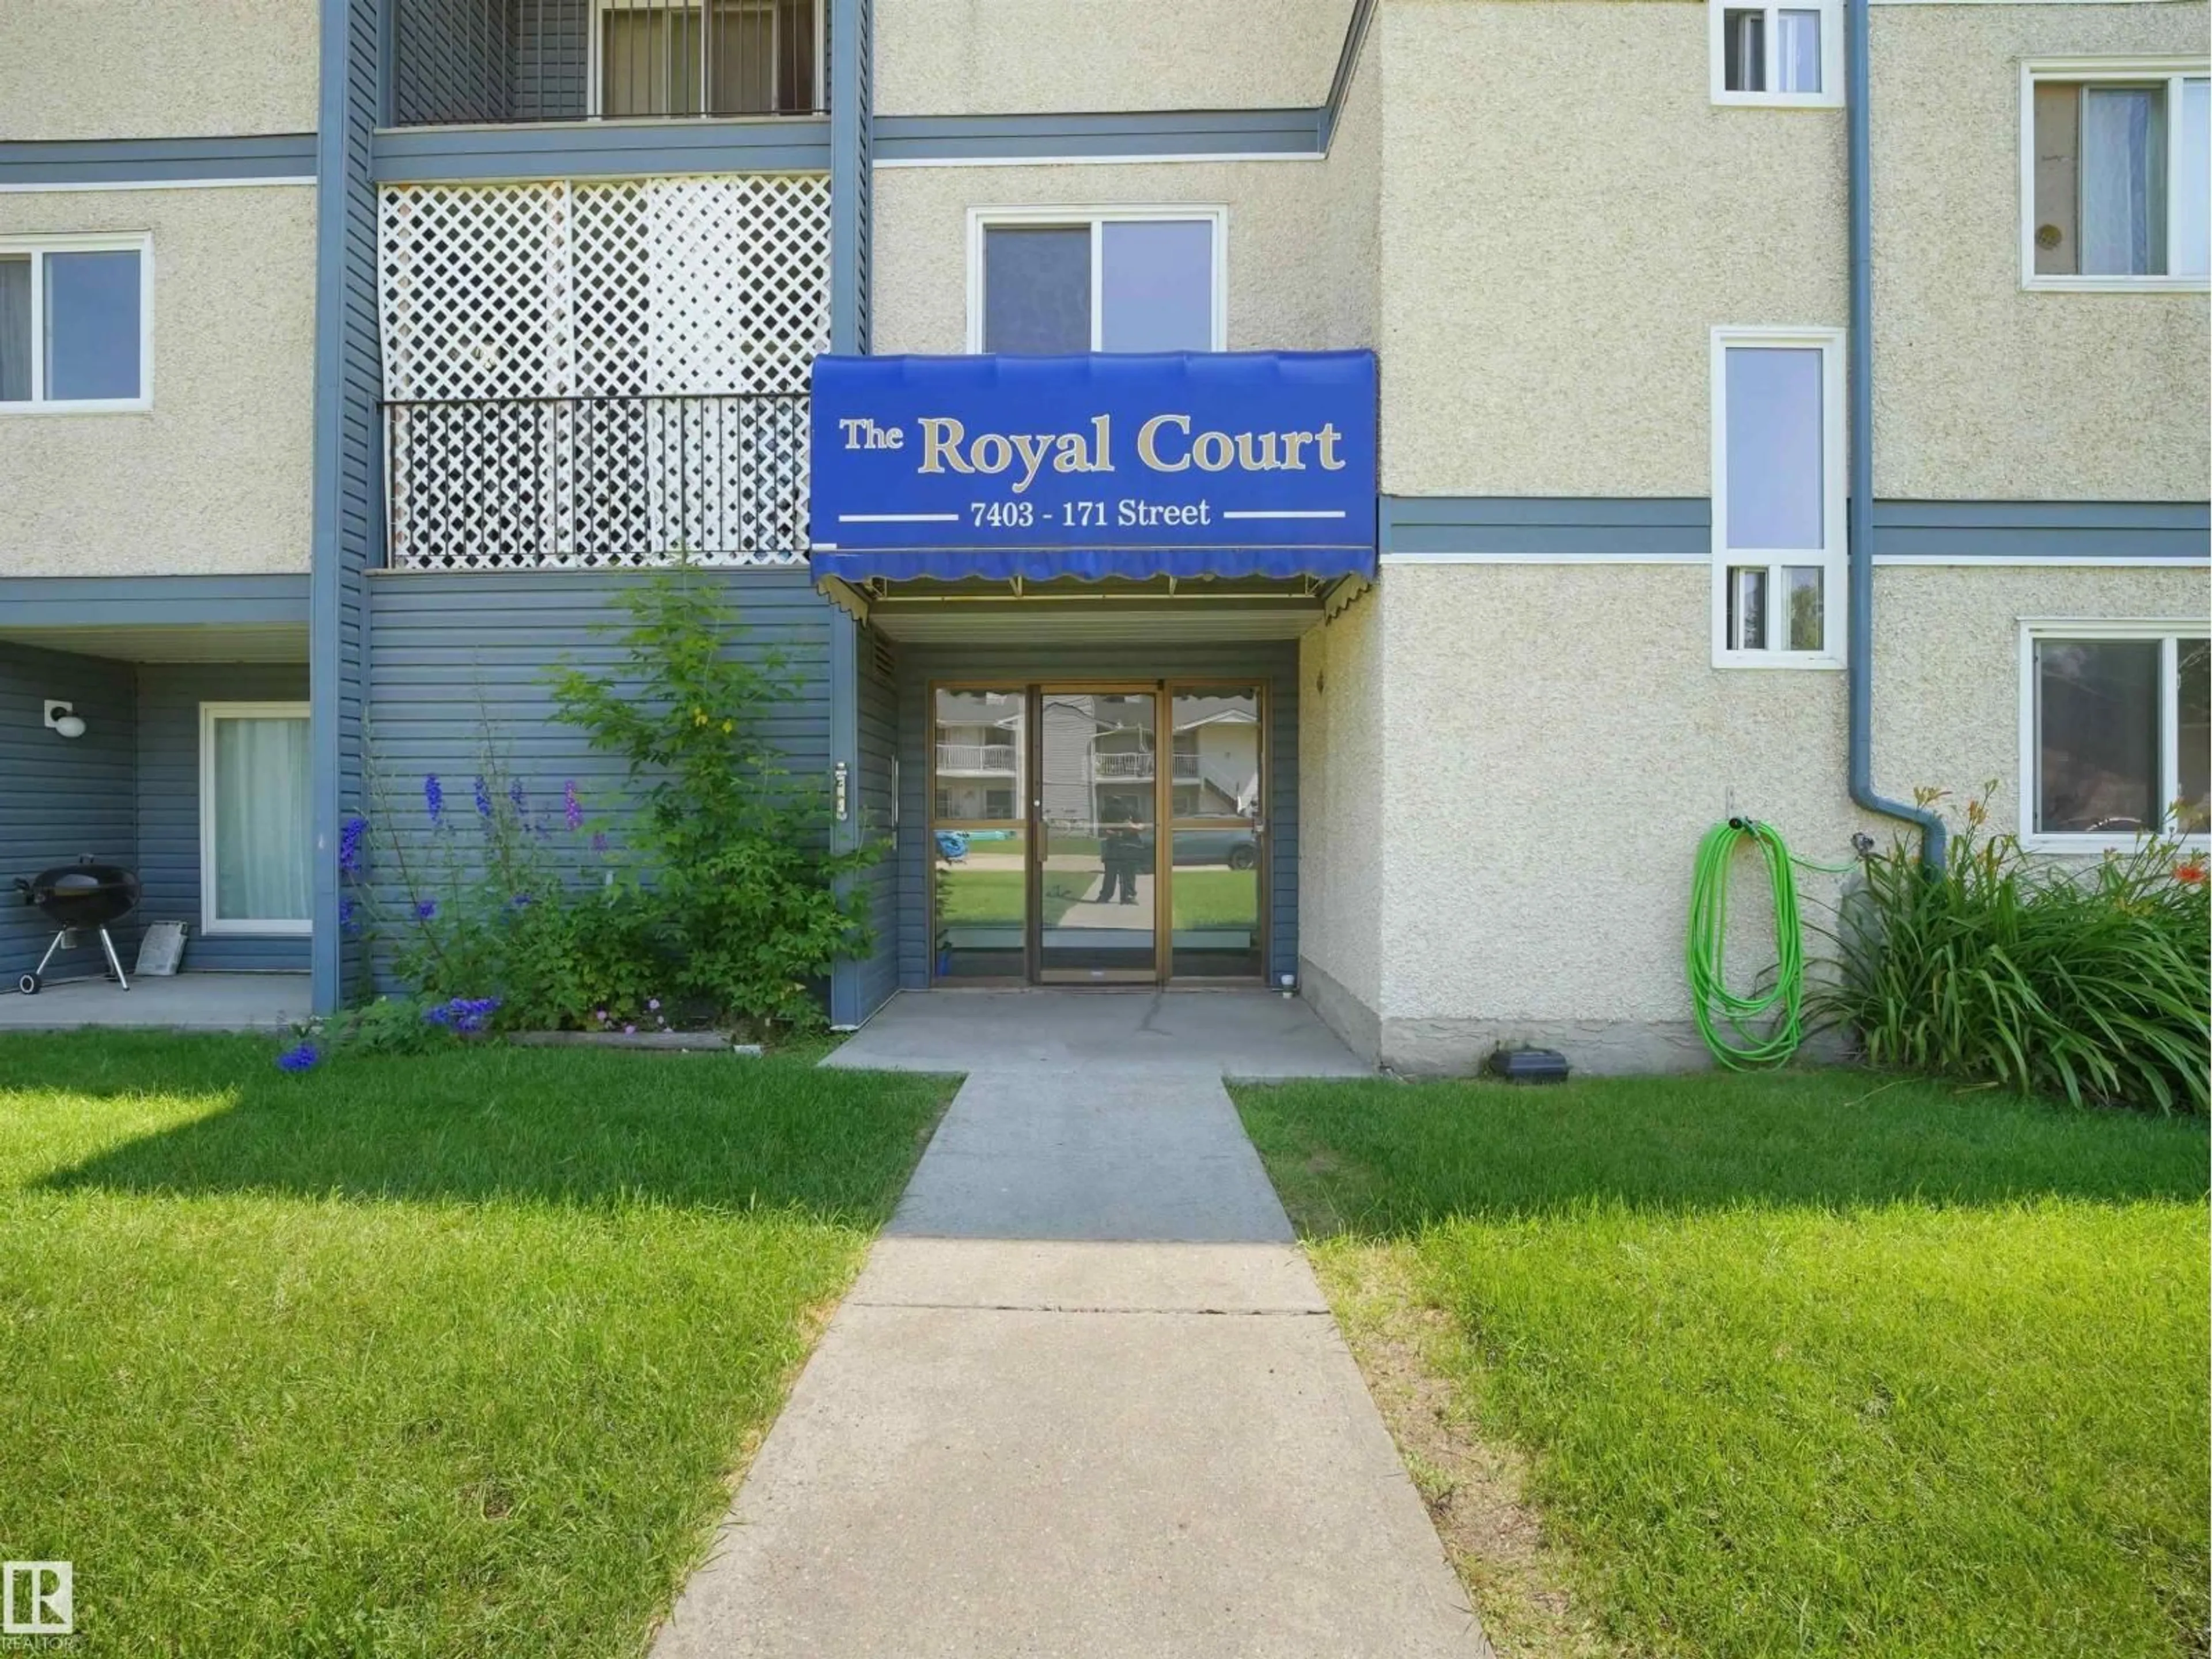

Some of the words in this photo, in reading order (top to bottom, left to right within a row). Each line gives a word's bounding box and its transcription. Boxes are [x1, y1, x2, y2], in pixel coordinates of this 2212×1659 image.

[839, 418, 904, 449] The
[918, 414, 1115, 493] Royal
[1137, 414, 1346, 472] Court
[971, 502, 1033, 528] 7403
[1063, 501, 1107, 527] 171
[1118, 499, 1211, 527] Street
